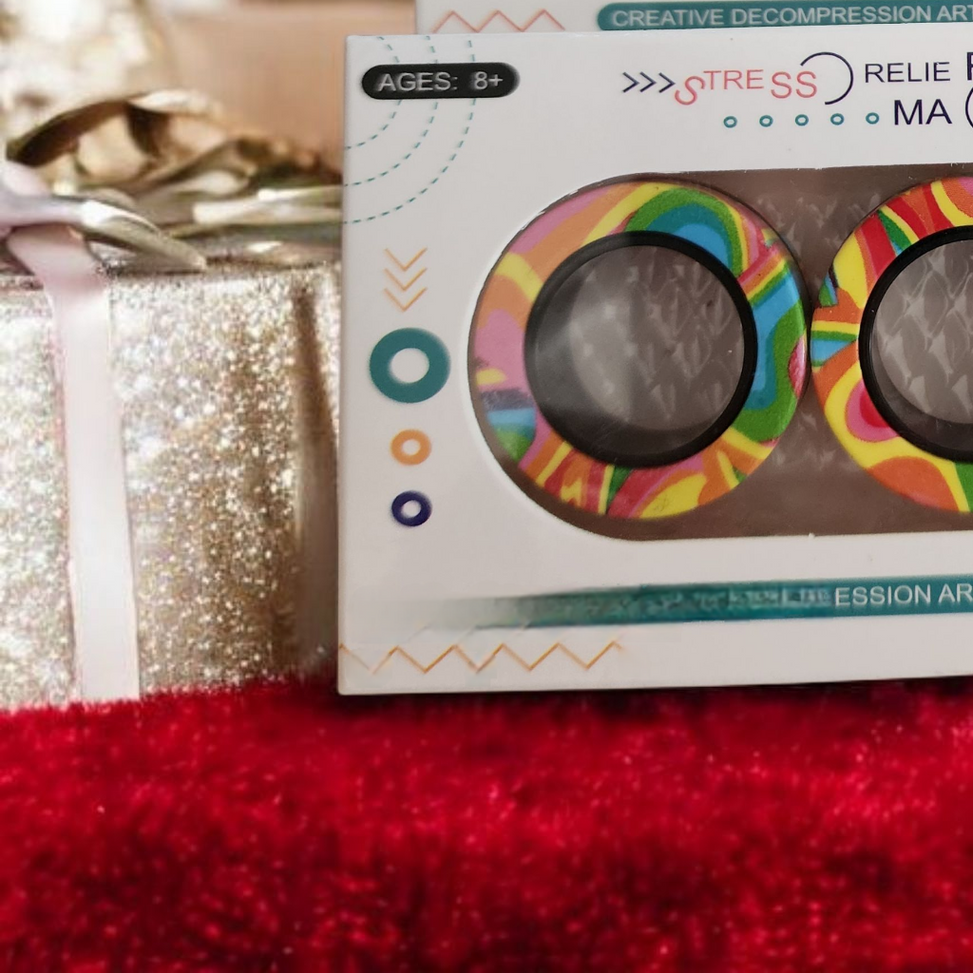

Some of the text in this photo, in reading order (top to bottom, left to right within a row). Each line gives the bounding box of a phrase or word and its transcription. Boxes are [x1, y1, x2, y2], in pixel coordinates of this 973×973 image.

[612, 8, 724, 26] CREATIVE
[731, 6, 931, 25] DECOMPRESSION
[377, 71, 503, 91] AGES: 8+
[674, 69, 817, 105] STRESS
